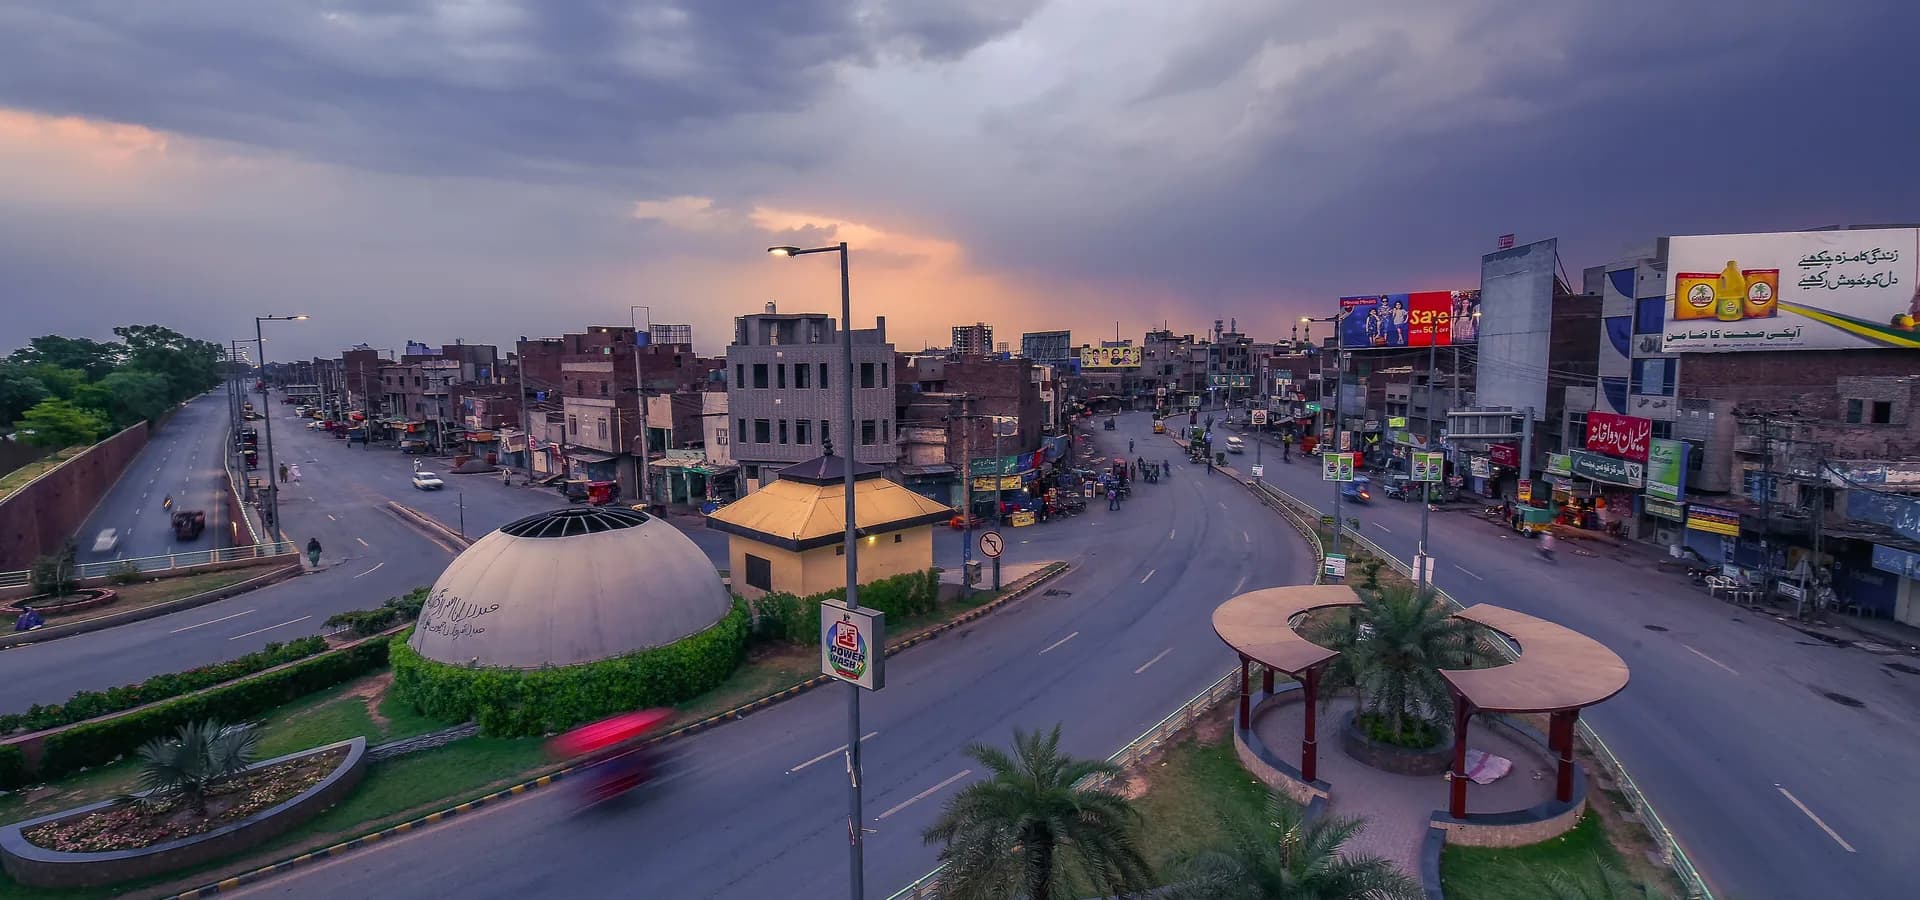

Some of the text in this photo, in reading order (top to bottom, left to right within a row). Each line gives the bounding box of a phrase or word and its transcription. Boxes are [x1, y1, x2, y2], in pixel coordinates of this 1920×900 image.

[1863, 272, 1883, 288] کو
[1879, 270, 1898, 288] دل
[831, 645, 865, 663] POWER
[831, 654, 856, 669] WASH
